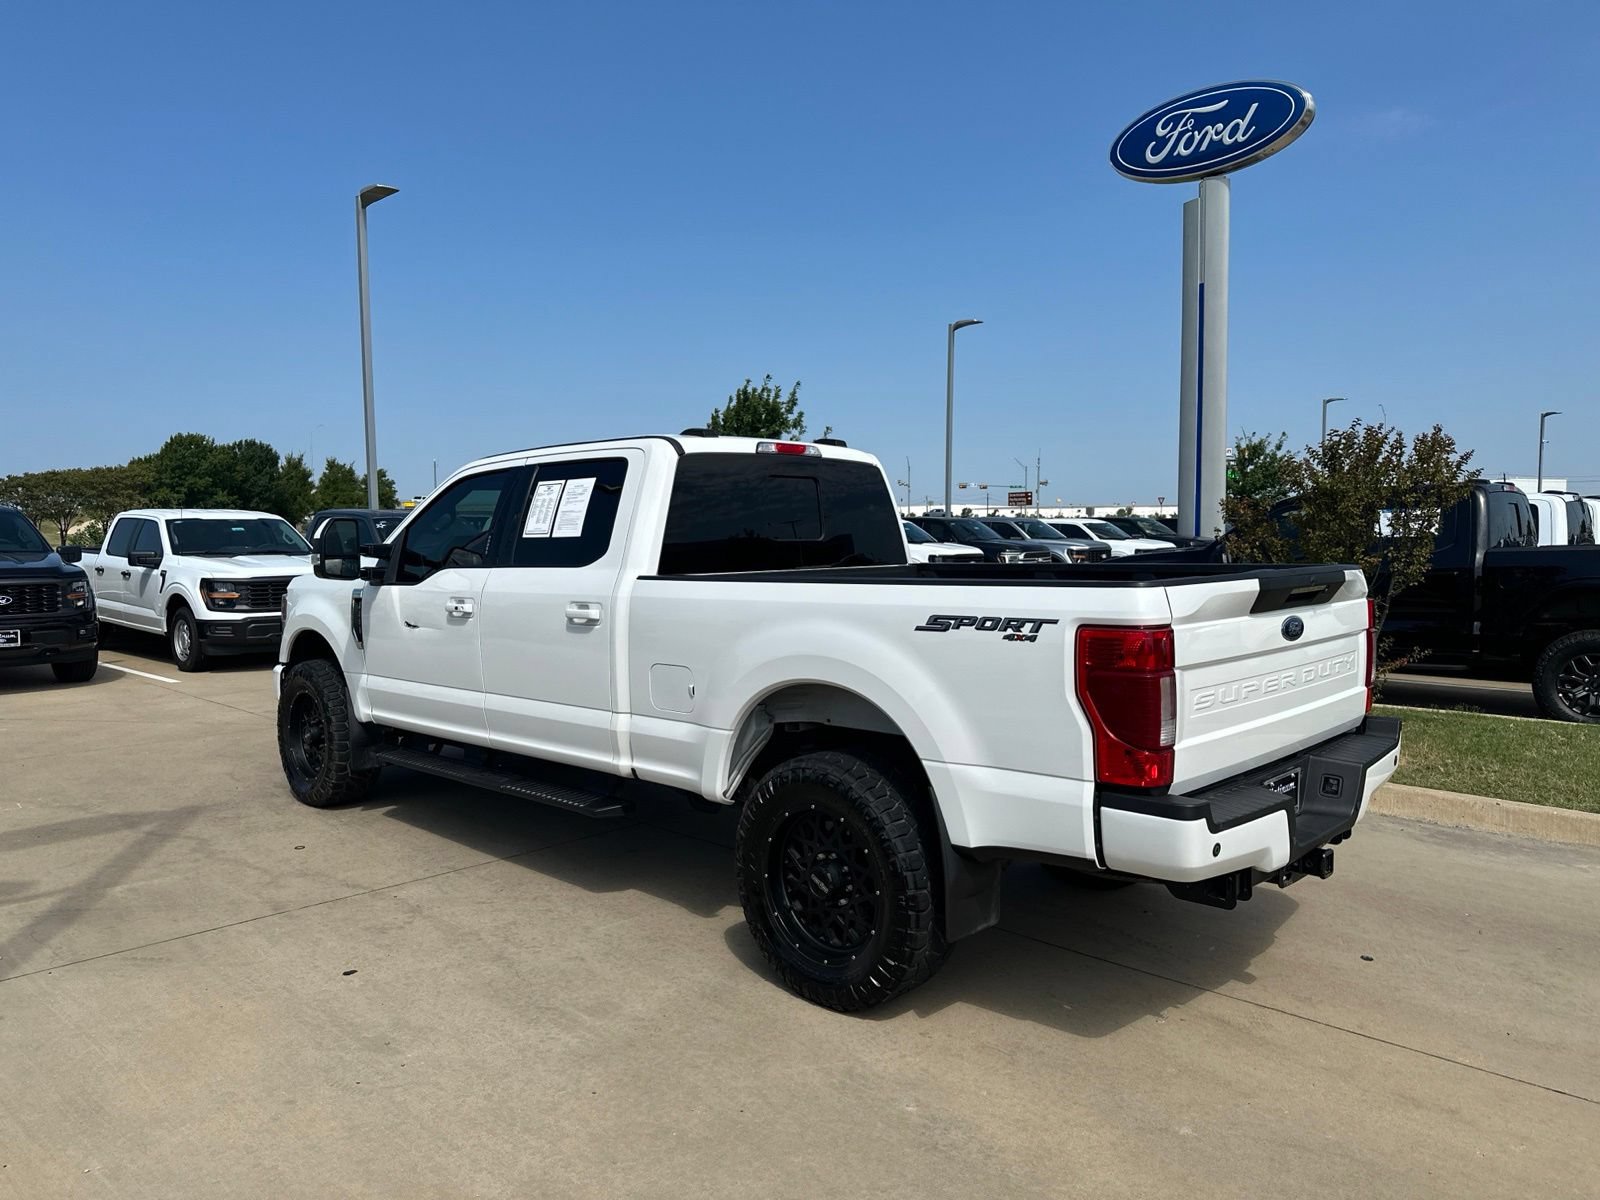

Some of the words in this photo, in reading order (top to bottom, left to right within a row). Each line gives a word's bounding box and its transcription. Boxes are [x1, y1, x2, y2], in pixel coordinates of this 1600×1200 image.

[1146, 99, 1259, 164] Ford
[914, 614, 1060, 634] SPORT
[1193, 672, 1297, 711] SUPER
[1301, 654, 1355, 684] DUTY
